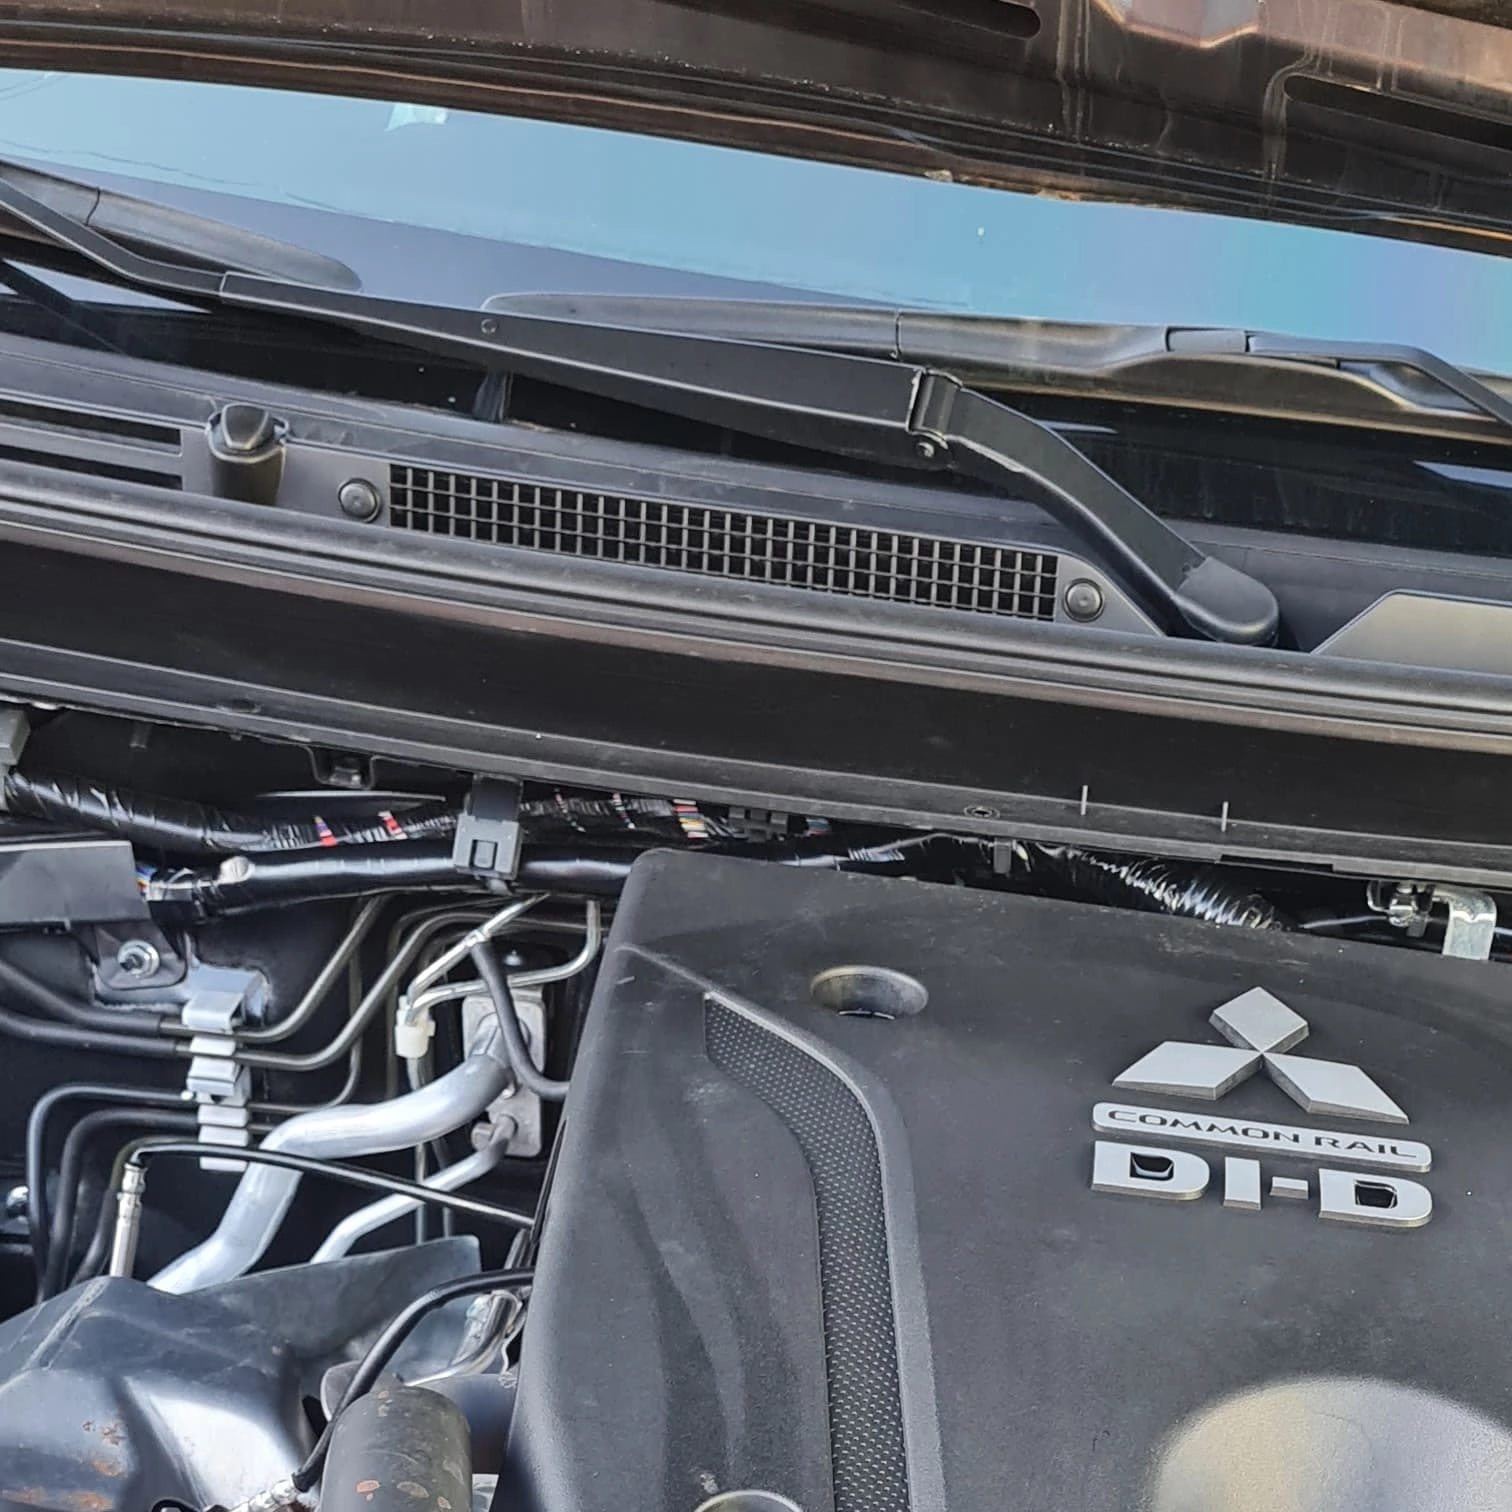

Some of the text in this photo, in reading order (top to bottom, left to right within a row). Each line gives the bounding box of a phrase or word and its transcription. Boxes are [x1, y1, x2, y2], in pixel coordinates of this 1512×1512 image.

[1108, 1109, 1417, 1158] COMMON RAIL
[1091, 1140, 1433, 1227] DI-D
